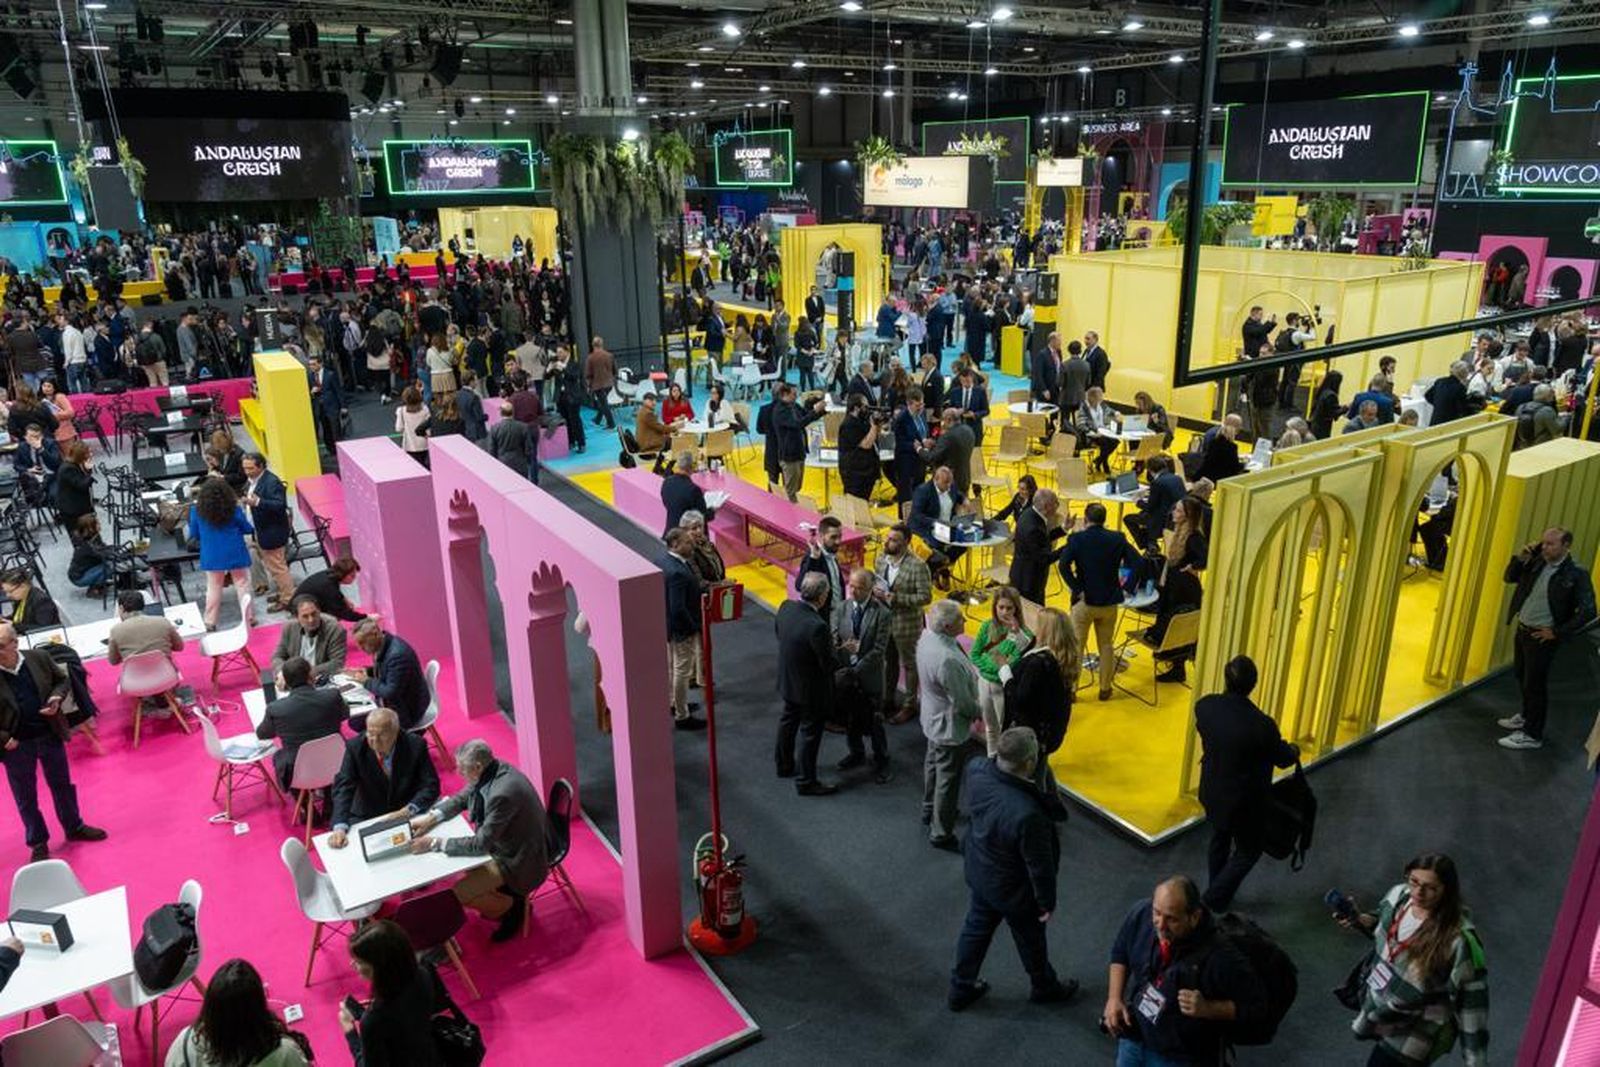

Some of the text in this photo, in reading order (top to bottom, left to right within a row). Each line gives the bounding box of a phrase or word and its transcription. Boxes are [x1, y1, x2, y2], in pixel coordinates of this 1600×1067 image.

[1115, 89, 1126, 107] B
[1119, 121, 1141, 132] AREA
[1268, 124, 1371, 143] ANDALUSIAN
[194, 145, 301, 161] ANDALUSIAN
[1289, 144, 1344, 160] CRUSH
[223, 161, 281, 176] CRUSH
[1496, 165, 1600, 184] SHOWCO
